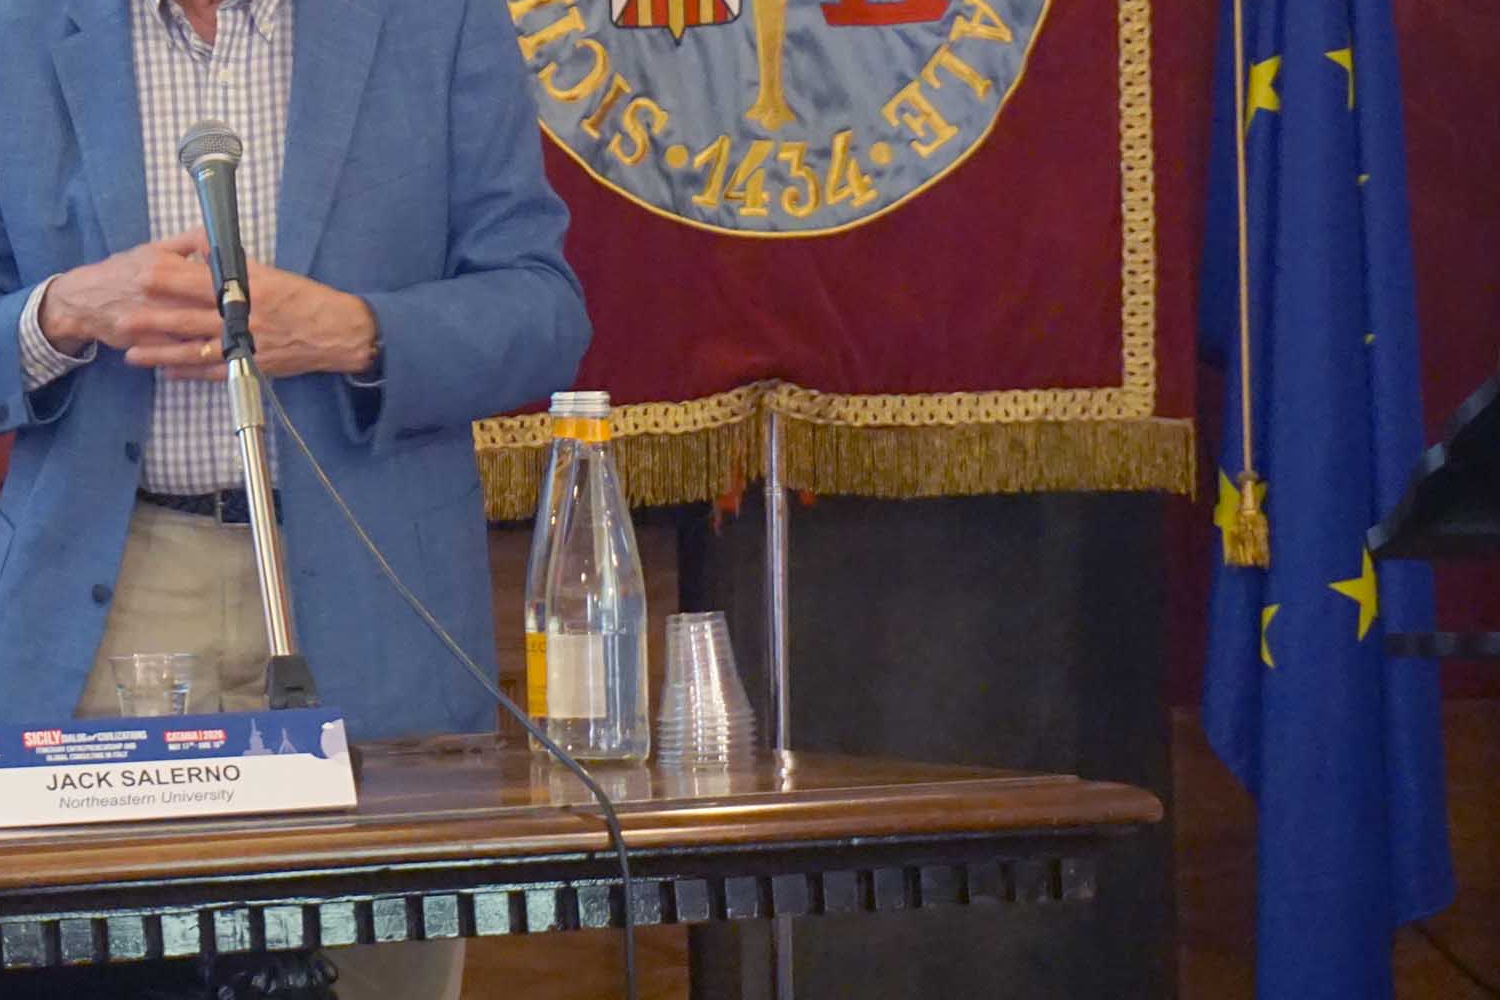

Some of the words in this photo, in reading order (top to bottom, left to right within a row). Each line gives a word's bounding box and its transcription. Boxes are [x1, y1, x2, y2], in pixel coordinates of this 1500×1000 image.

[23, 730, 61, 747] SICILY
[46, 770, 116, 792] JACK
[120, 764, 241, 788] SALERNO
[59, 792, 157, 810] Northeastern
[161, 789, 236, 805] University
